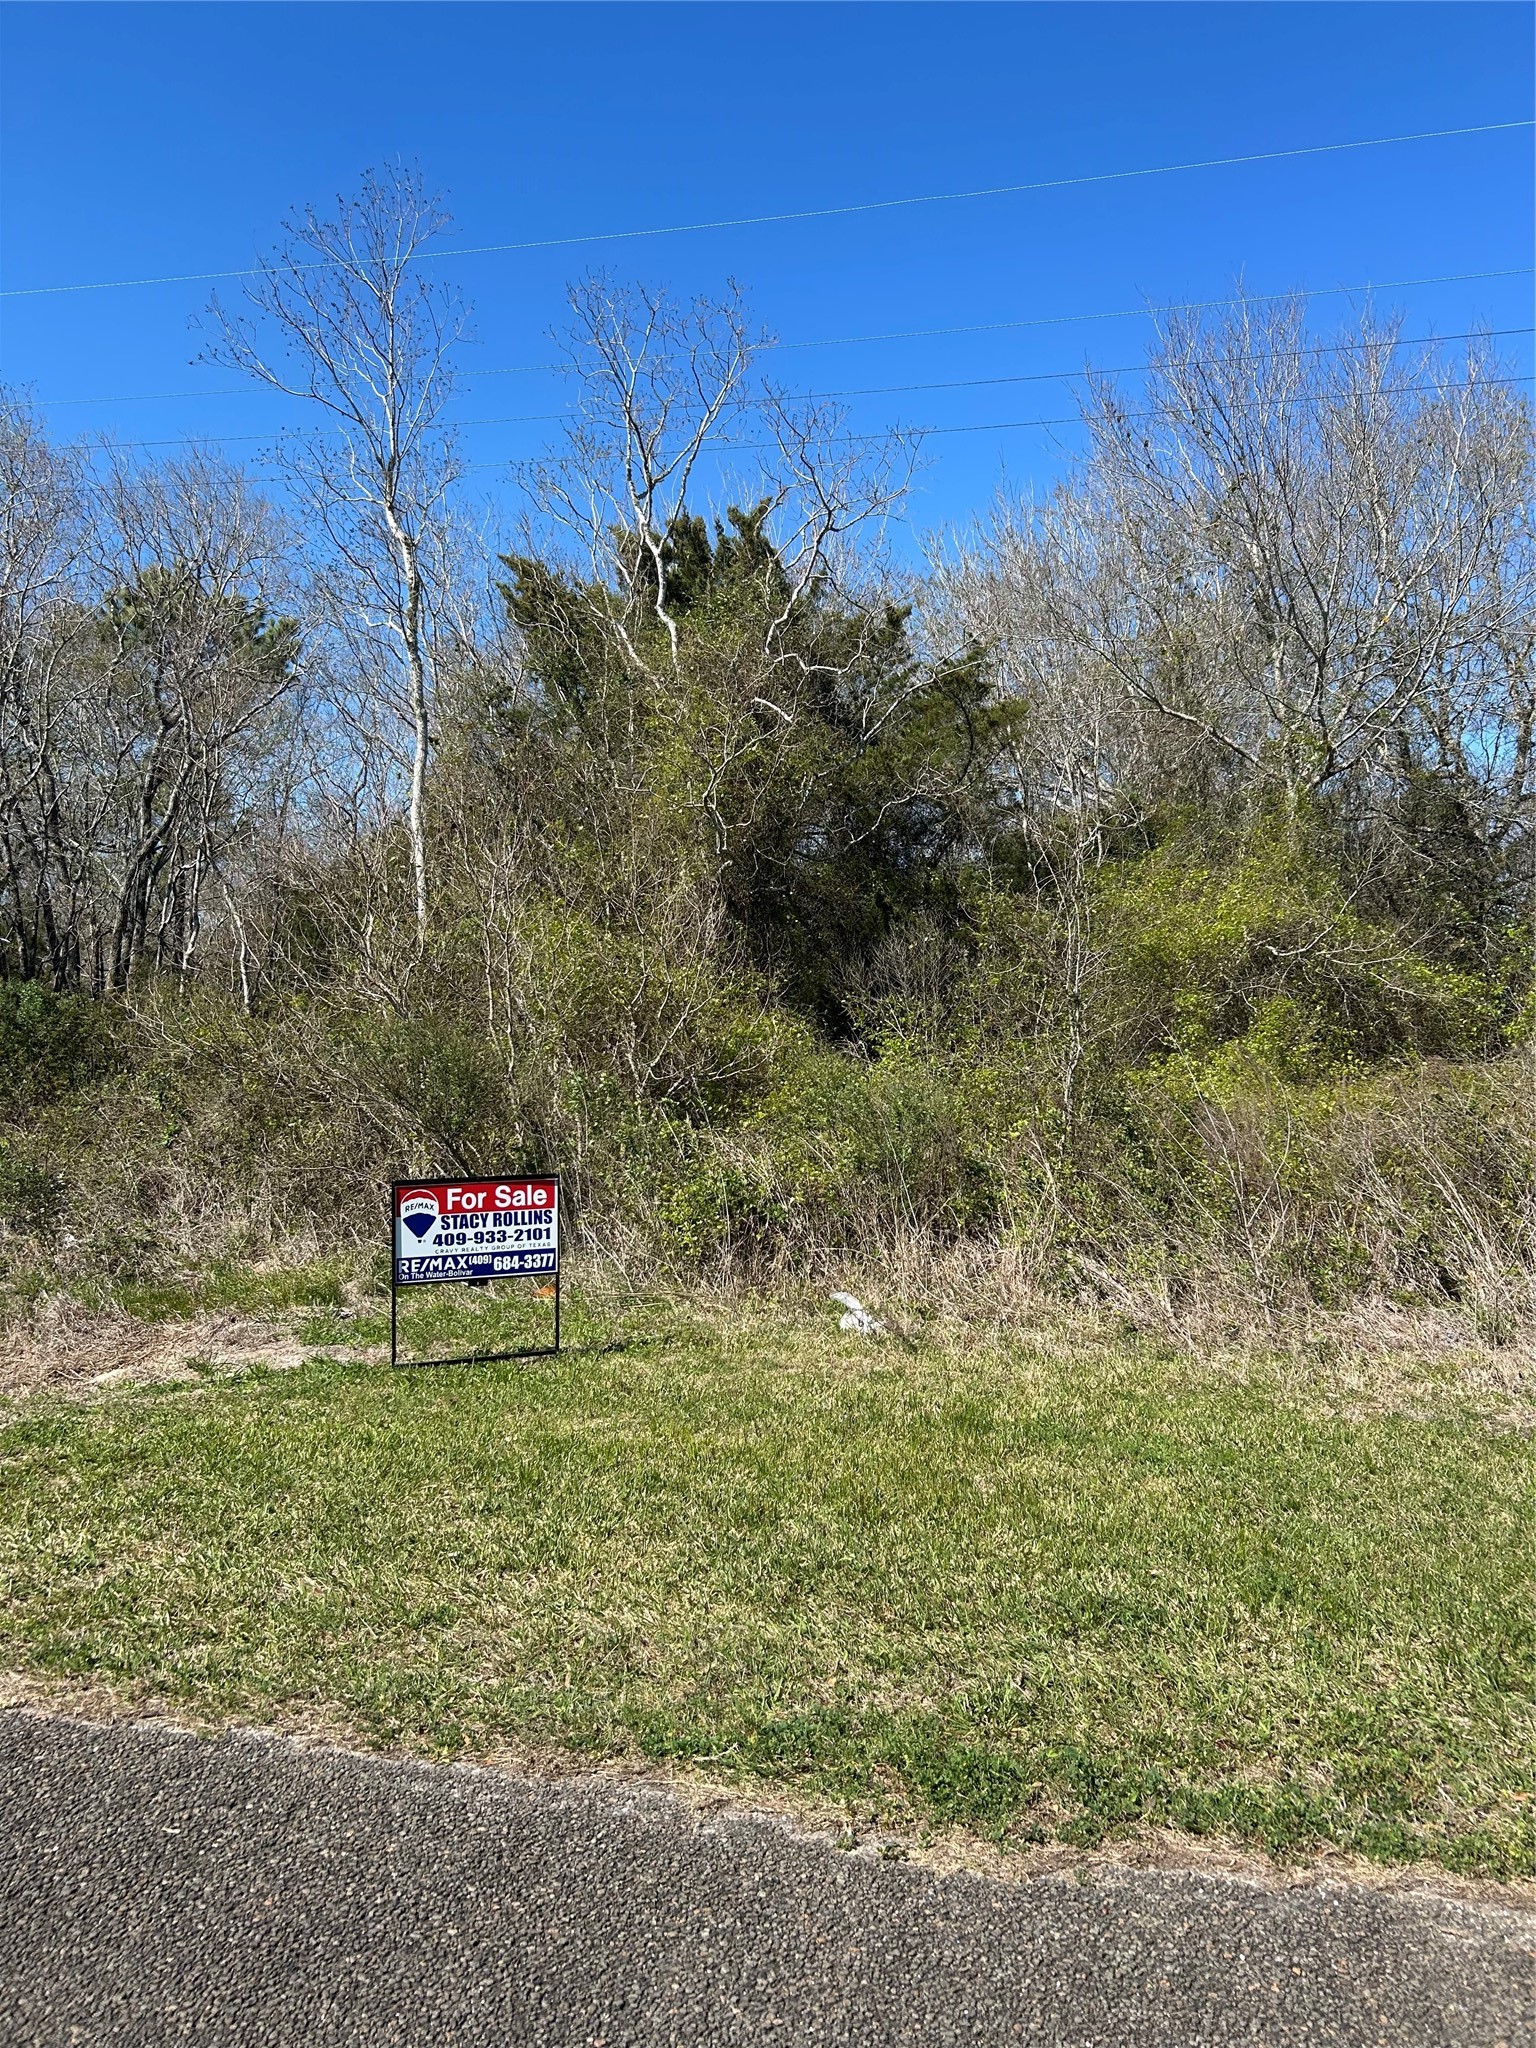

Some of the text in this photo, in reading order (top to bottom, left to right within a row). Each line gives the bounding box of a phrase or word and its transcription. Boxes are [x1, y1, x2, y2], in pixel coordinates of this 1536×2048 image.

[447, 1184, 547, 1210] For Sale
[404, 1202, 435, 1212] RE/MAX
[441, 1210, 553, 1230] STACY ROLLINS
[433, 1228, 551, 1247] 409-933-2101
[399, 1253, 554, 1273] RE/MAX (409) 684-3377
[411, 1272, 424, 1280] The
[426, 1269, 473, 1278] Water-Bolivar
